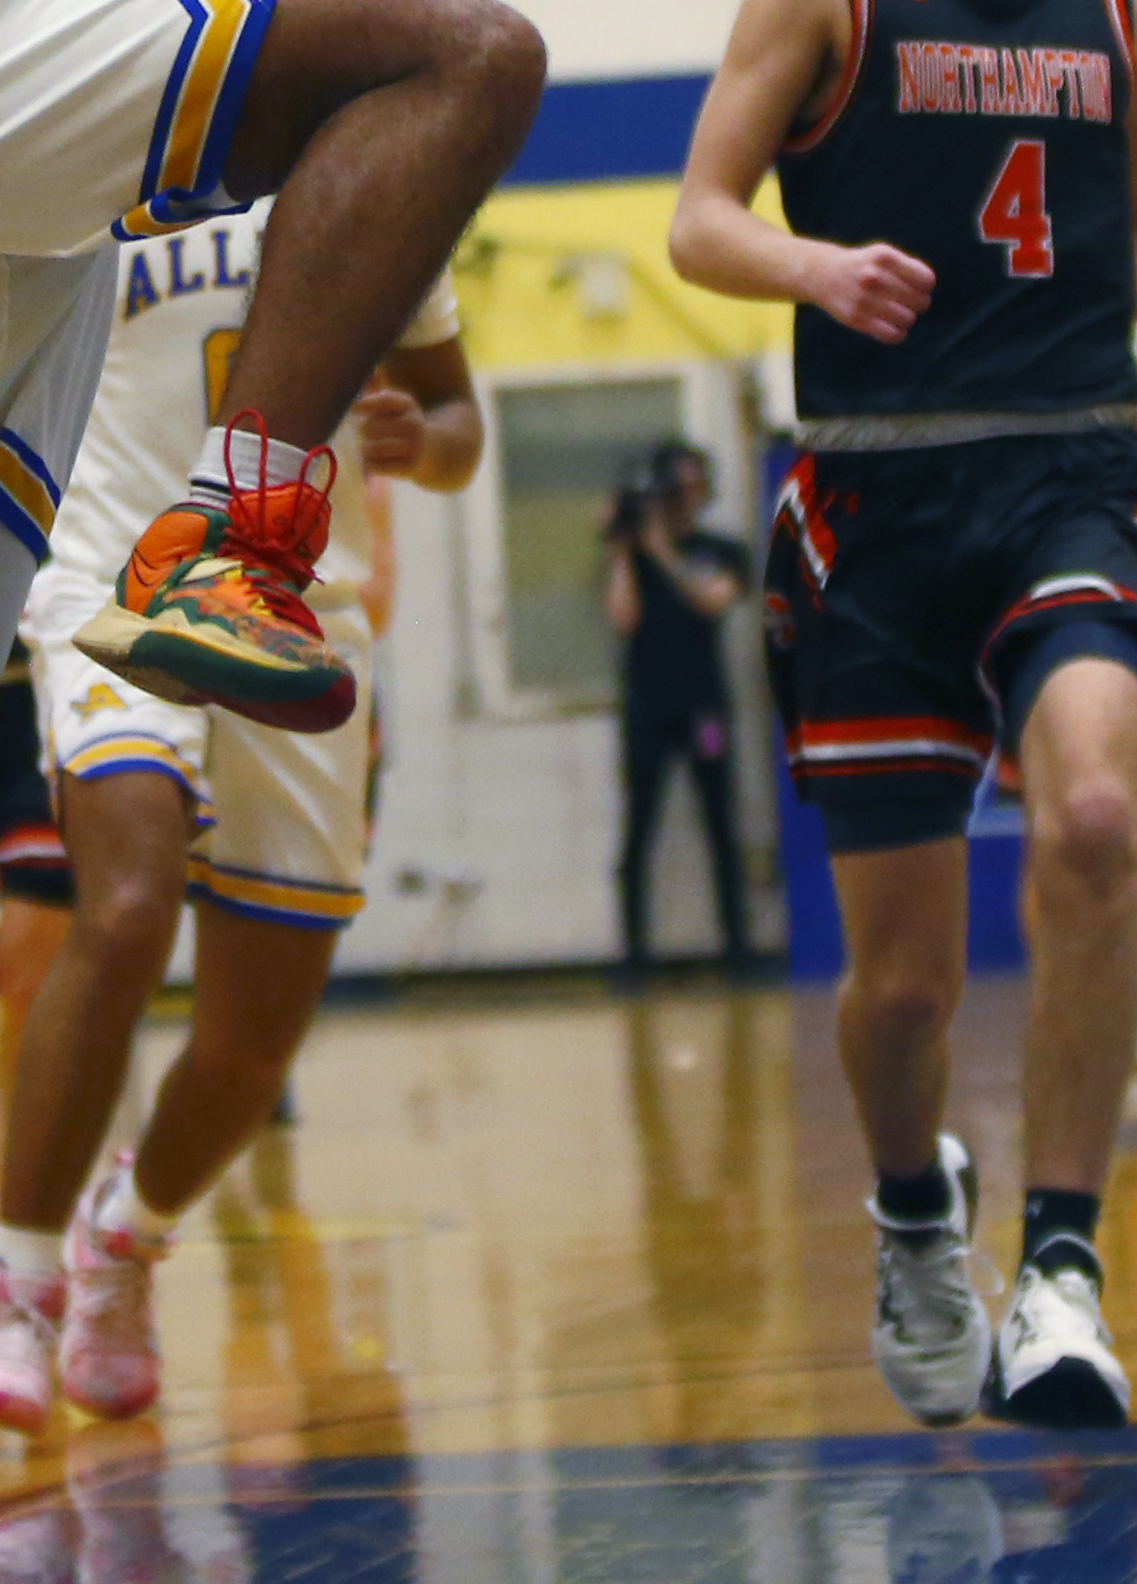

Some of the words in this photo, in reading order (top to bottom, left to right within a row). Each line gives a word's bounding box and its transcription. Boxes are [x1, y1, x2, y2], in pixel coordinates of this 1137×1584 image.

[897, 40, 1112, 124] NORTHAMPTON
[979, 138, 1055, 278] 4
[120, 228, 264, 321] ALL
